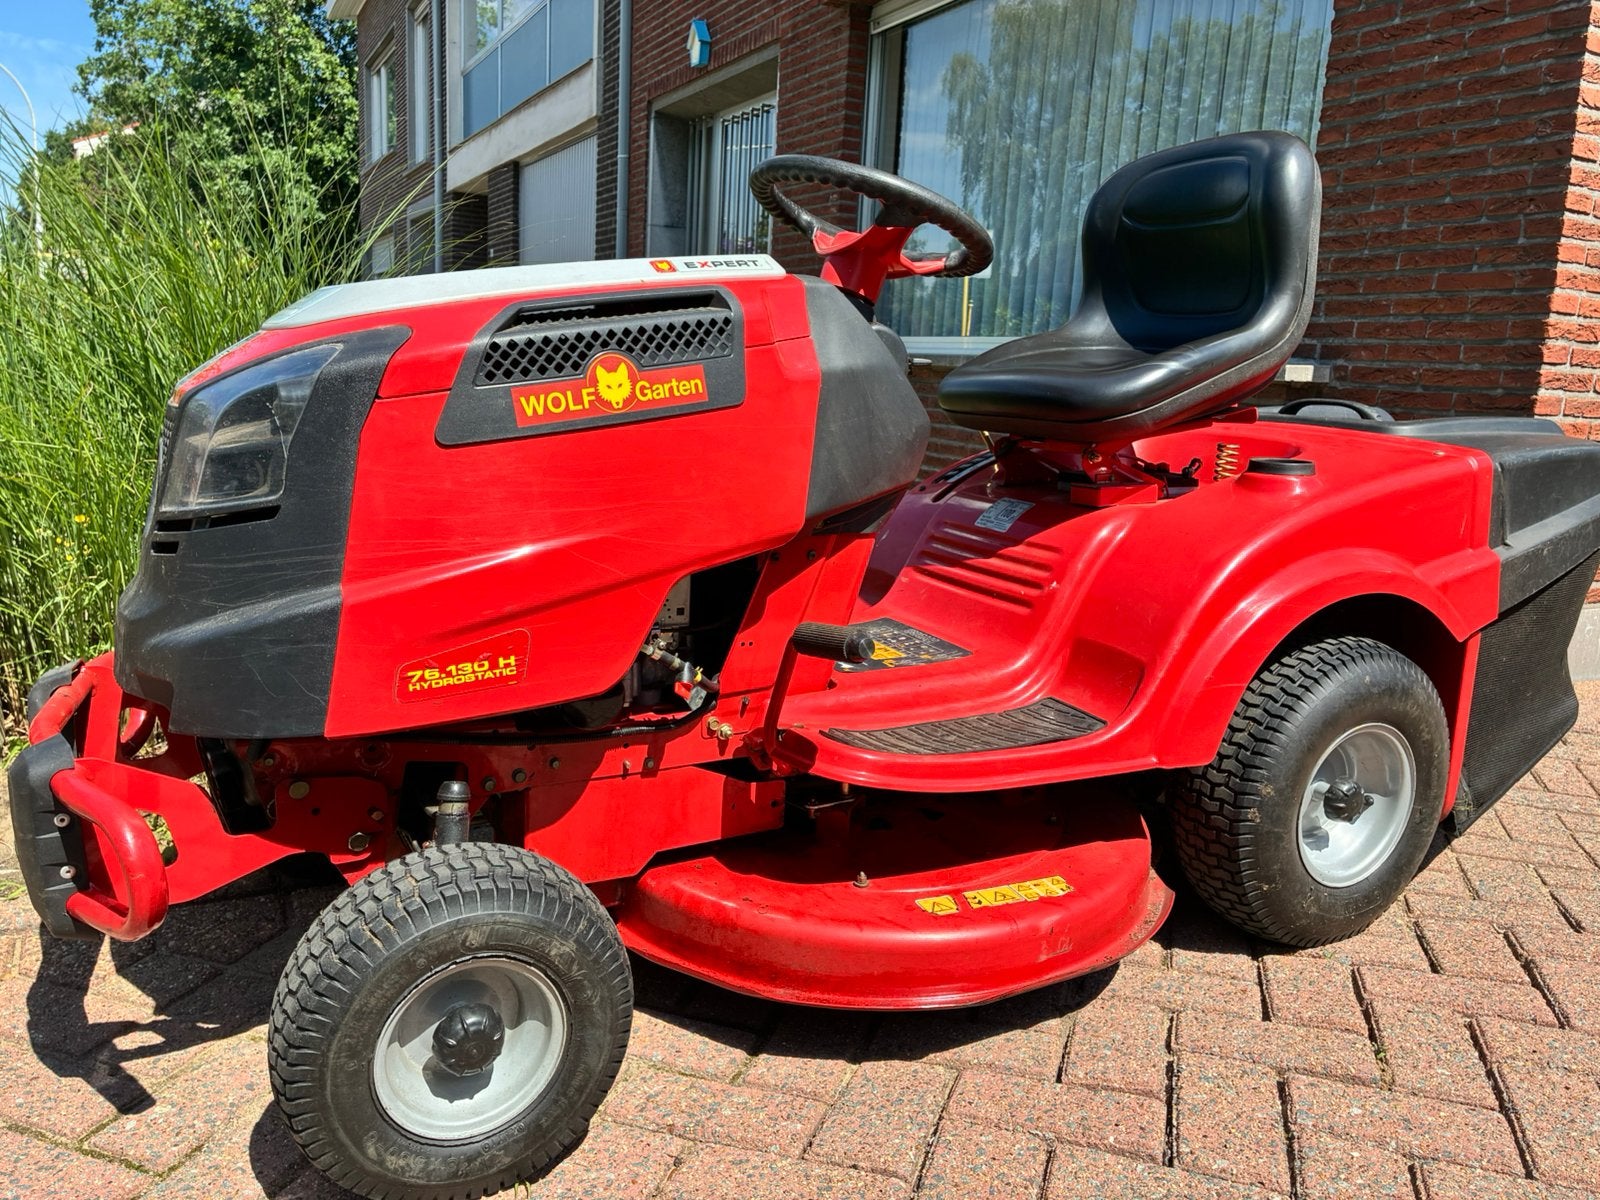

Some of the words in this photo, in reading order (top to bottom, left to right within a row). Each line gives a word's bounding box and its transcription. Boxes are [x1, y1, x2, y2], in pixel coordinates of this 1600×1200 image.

[684, 259, 759, 269] EXPERT
[519, 387, 596, 417] WOLF
[635, 378, 703, 402] Garten
[407, 661, 489, 683] 76.130
[498, 655, 516, 668] H
[408, 667, 517, 691] HYDROSTATIC
